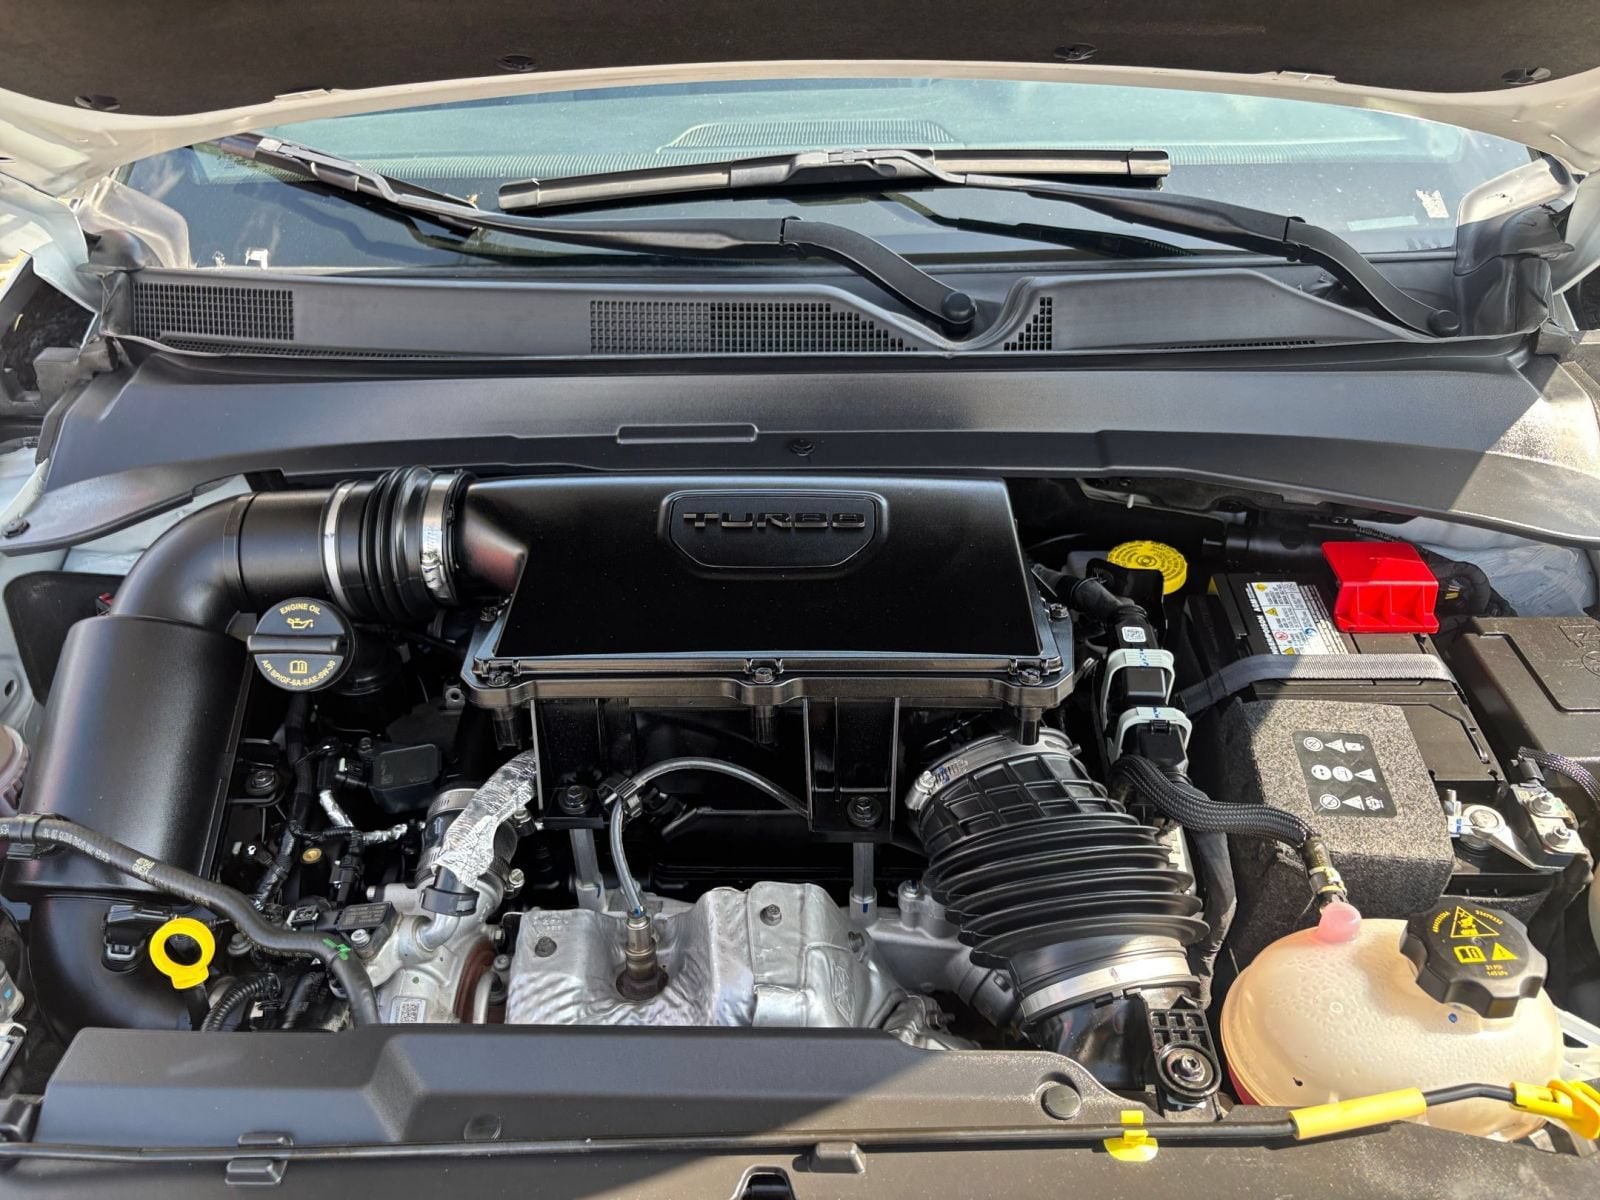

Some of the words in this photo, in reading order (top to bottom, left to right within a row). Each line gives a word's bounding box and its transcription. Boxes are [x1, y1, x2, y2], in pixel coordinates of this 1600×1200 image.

[683, 512, 866, 528] TURBO
[279, 603, 308, 614] ENGINE
[309, 604, 321, 615] OIL
[261, 660, 272, 673] API
